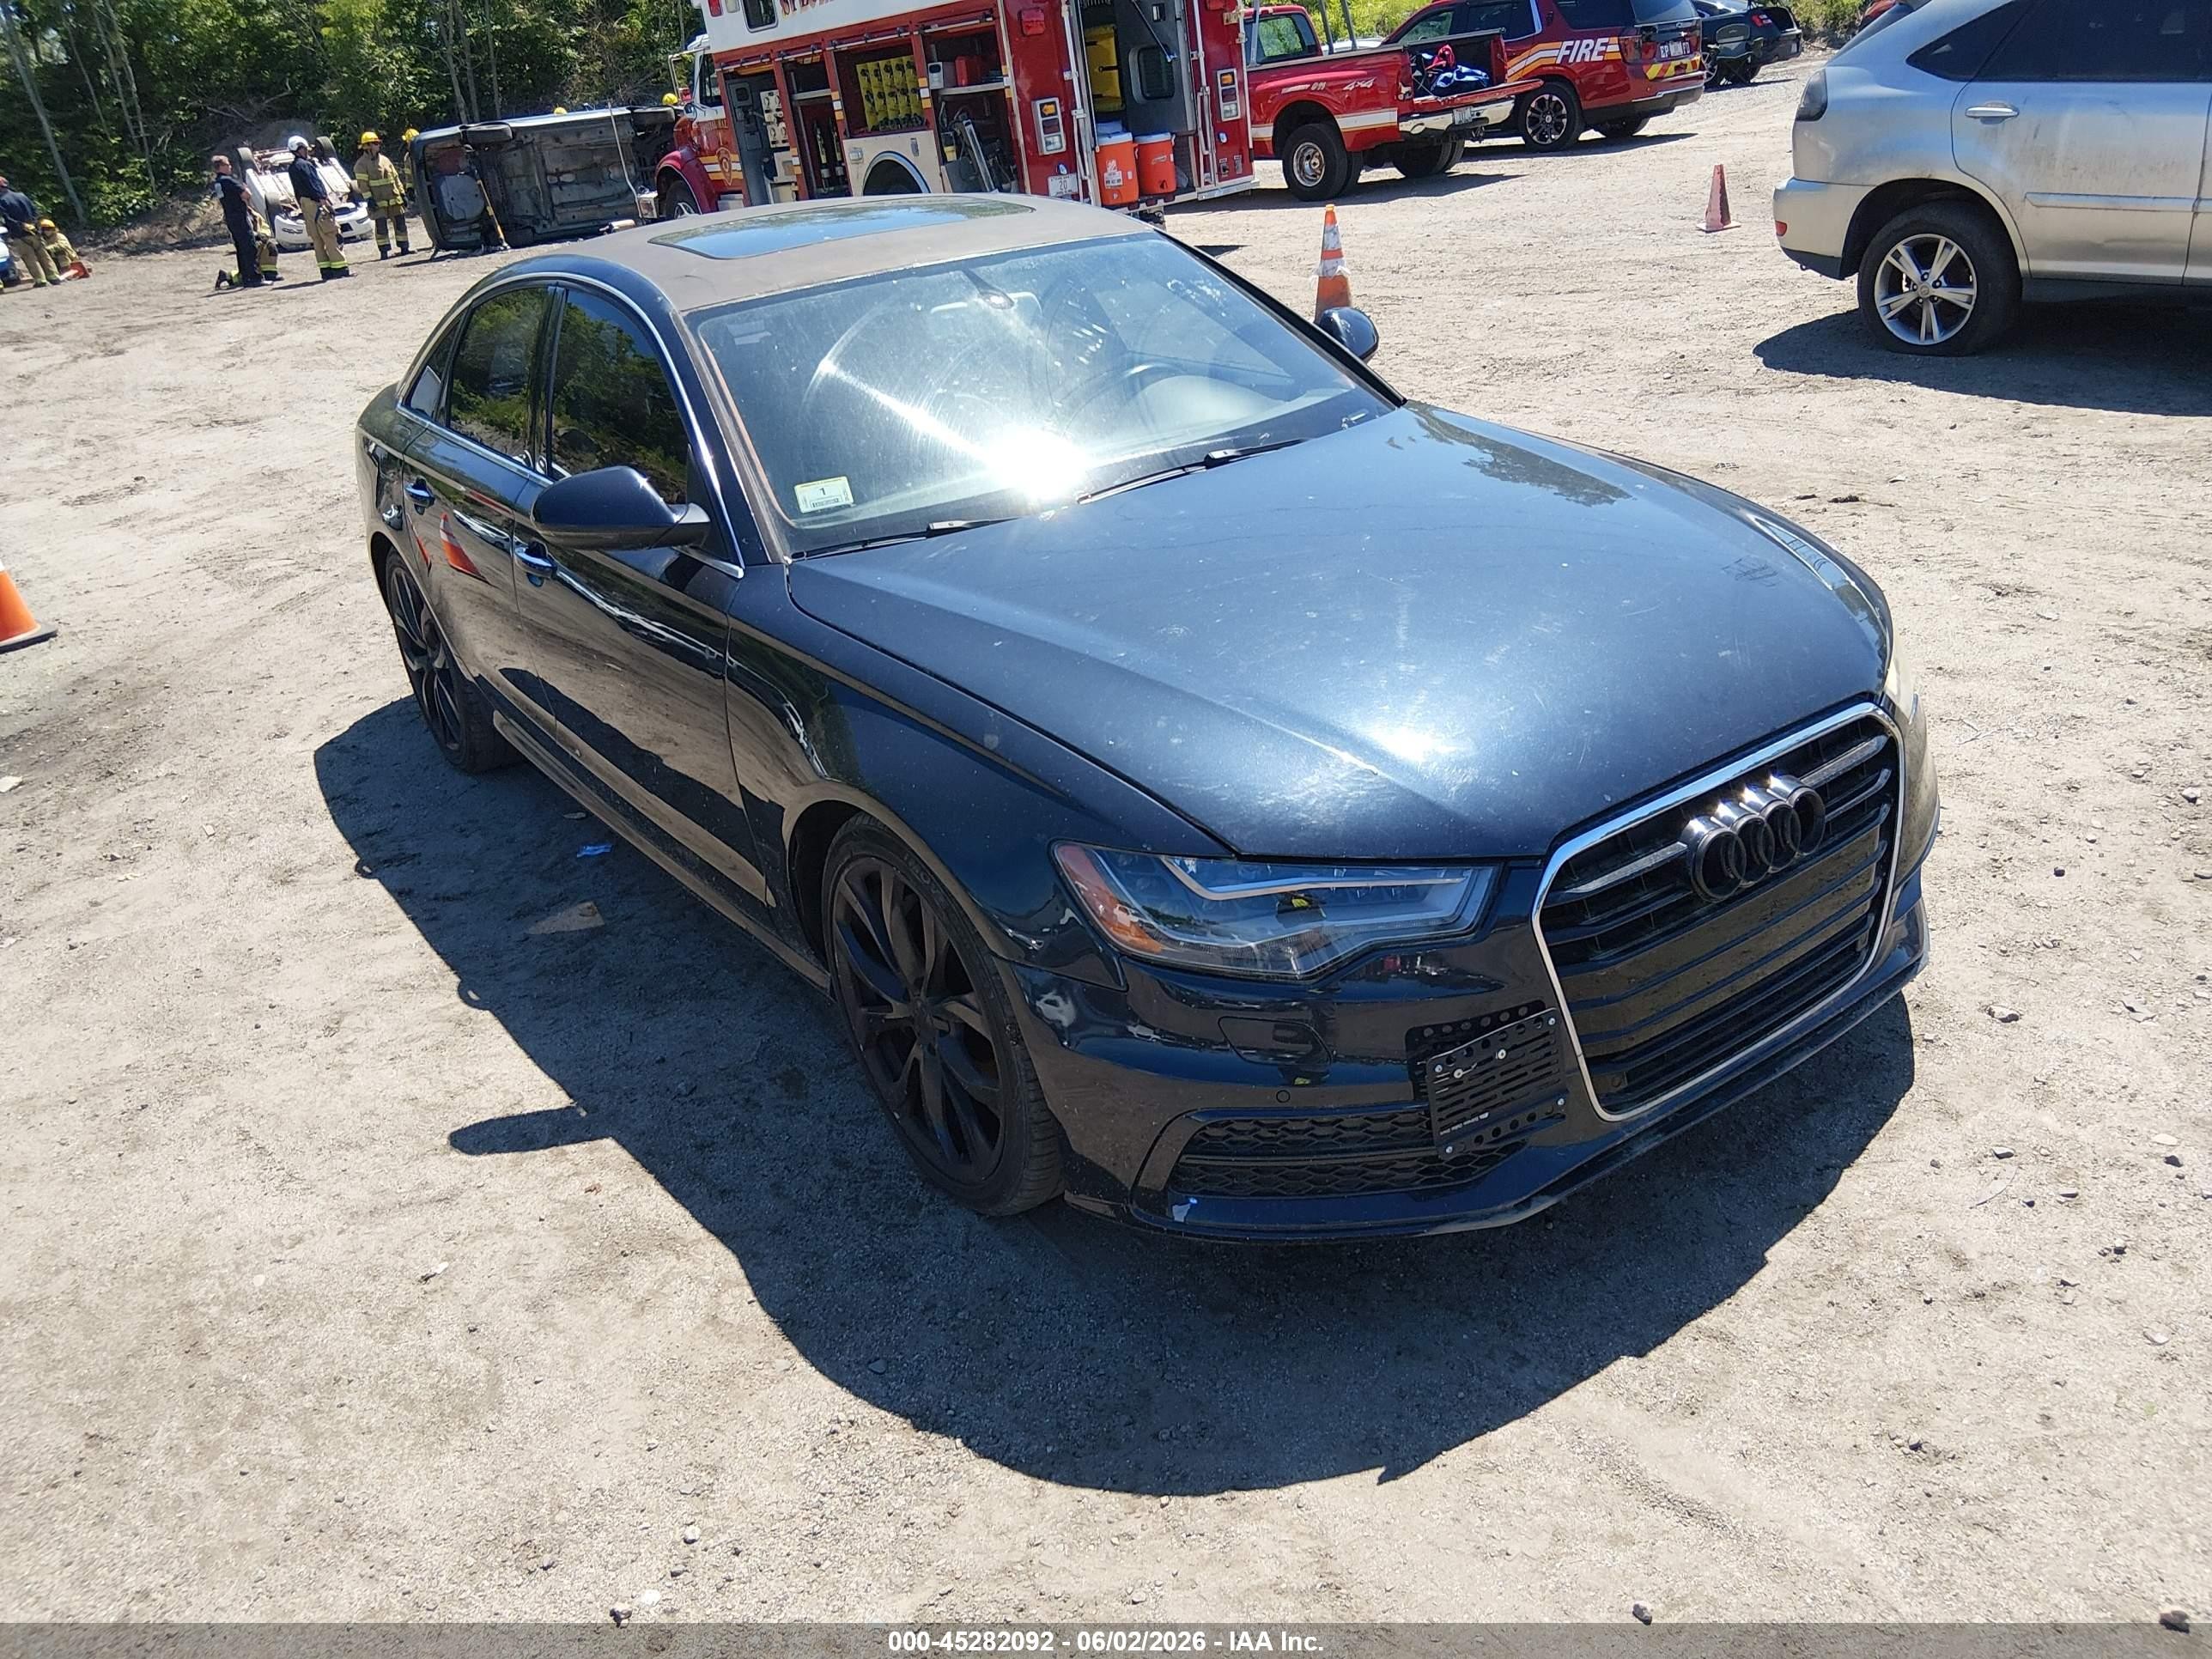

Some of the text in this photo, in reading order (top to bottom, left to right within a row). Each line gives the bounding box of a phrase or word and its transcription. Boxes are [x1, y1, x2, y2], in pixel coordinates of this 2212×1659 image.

[1556, 37, 1609, 64] FIRE
[1660, 45, 1669, 58] EP
[1682, 41, 1691, 54] FD
[1059, 179, 1067, 191] 20
